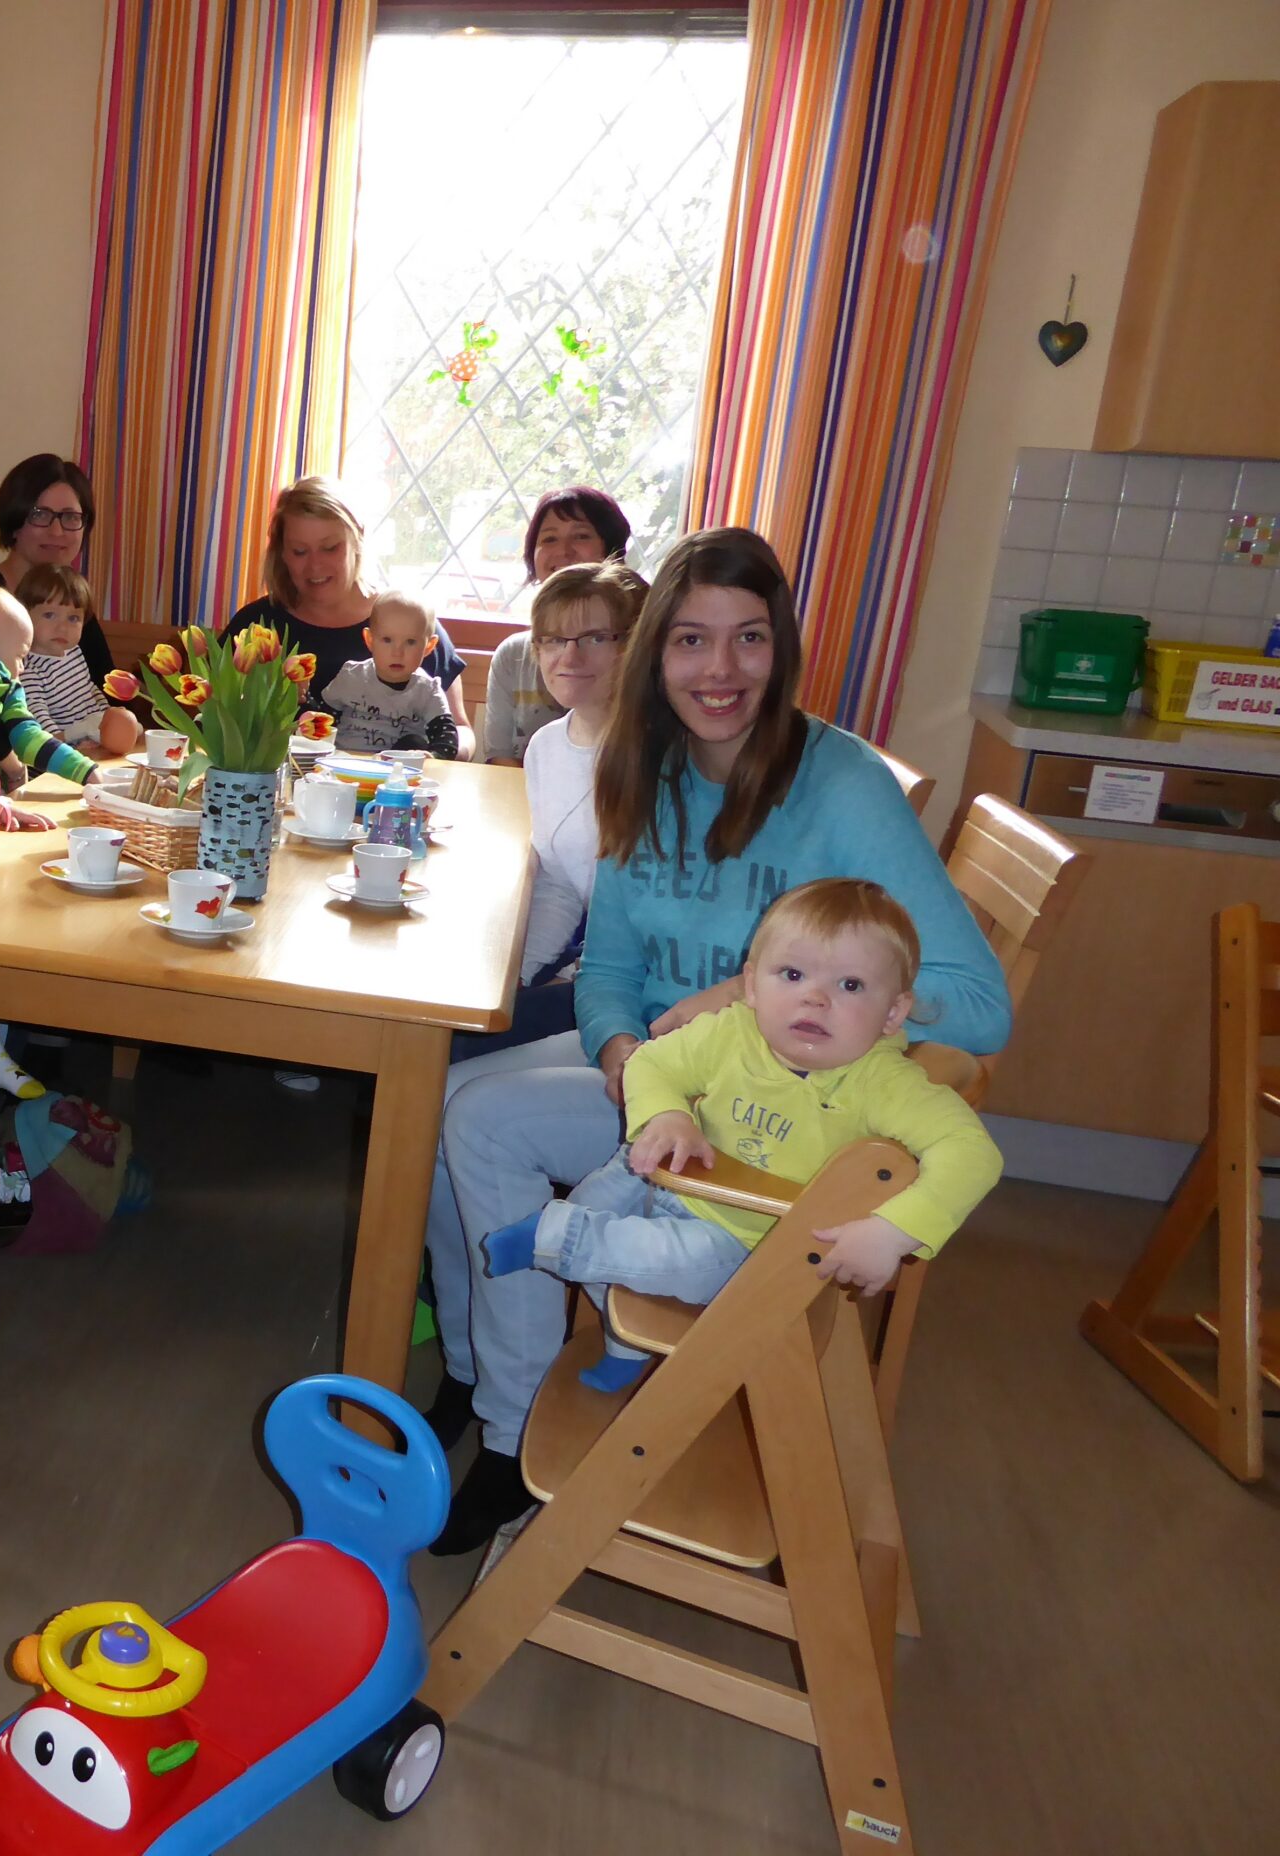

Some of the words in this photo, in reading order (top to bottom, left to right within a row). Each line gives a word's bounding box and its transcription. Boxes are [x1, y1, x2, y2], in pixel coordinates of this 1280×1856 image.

[1212, 671, 1258, 688] GELBER
[1217, 698, 1240, 711] und
[1241, 699, 1273, 714] GLAS
[746, 862, 788, 912] IN
[732, 1097, 793, 1142] CATCH
[862, 1817, 898, 1838] hauck
